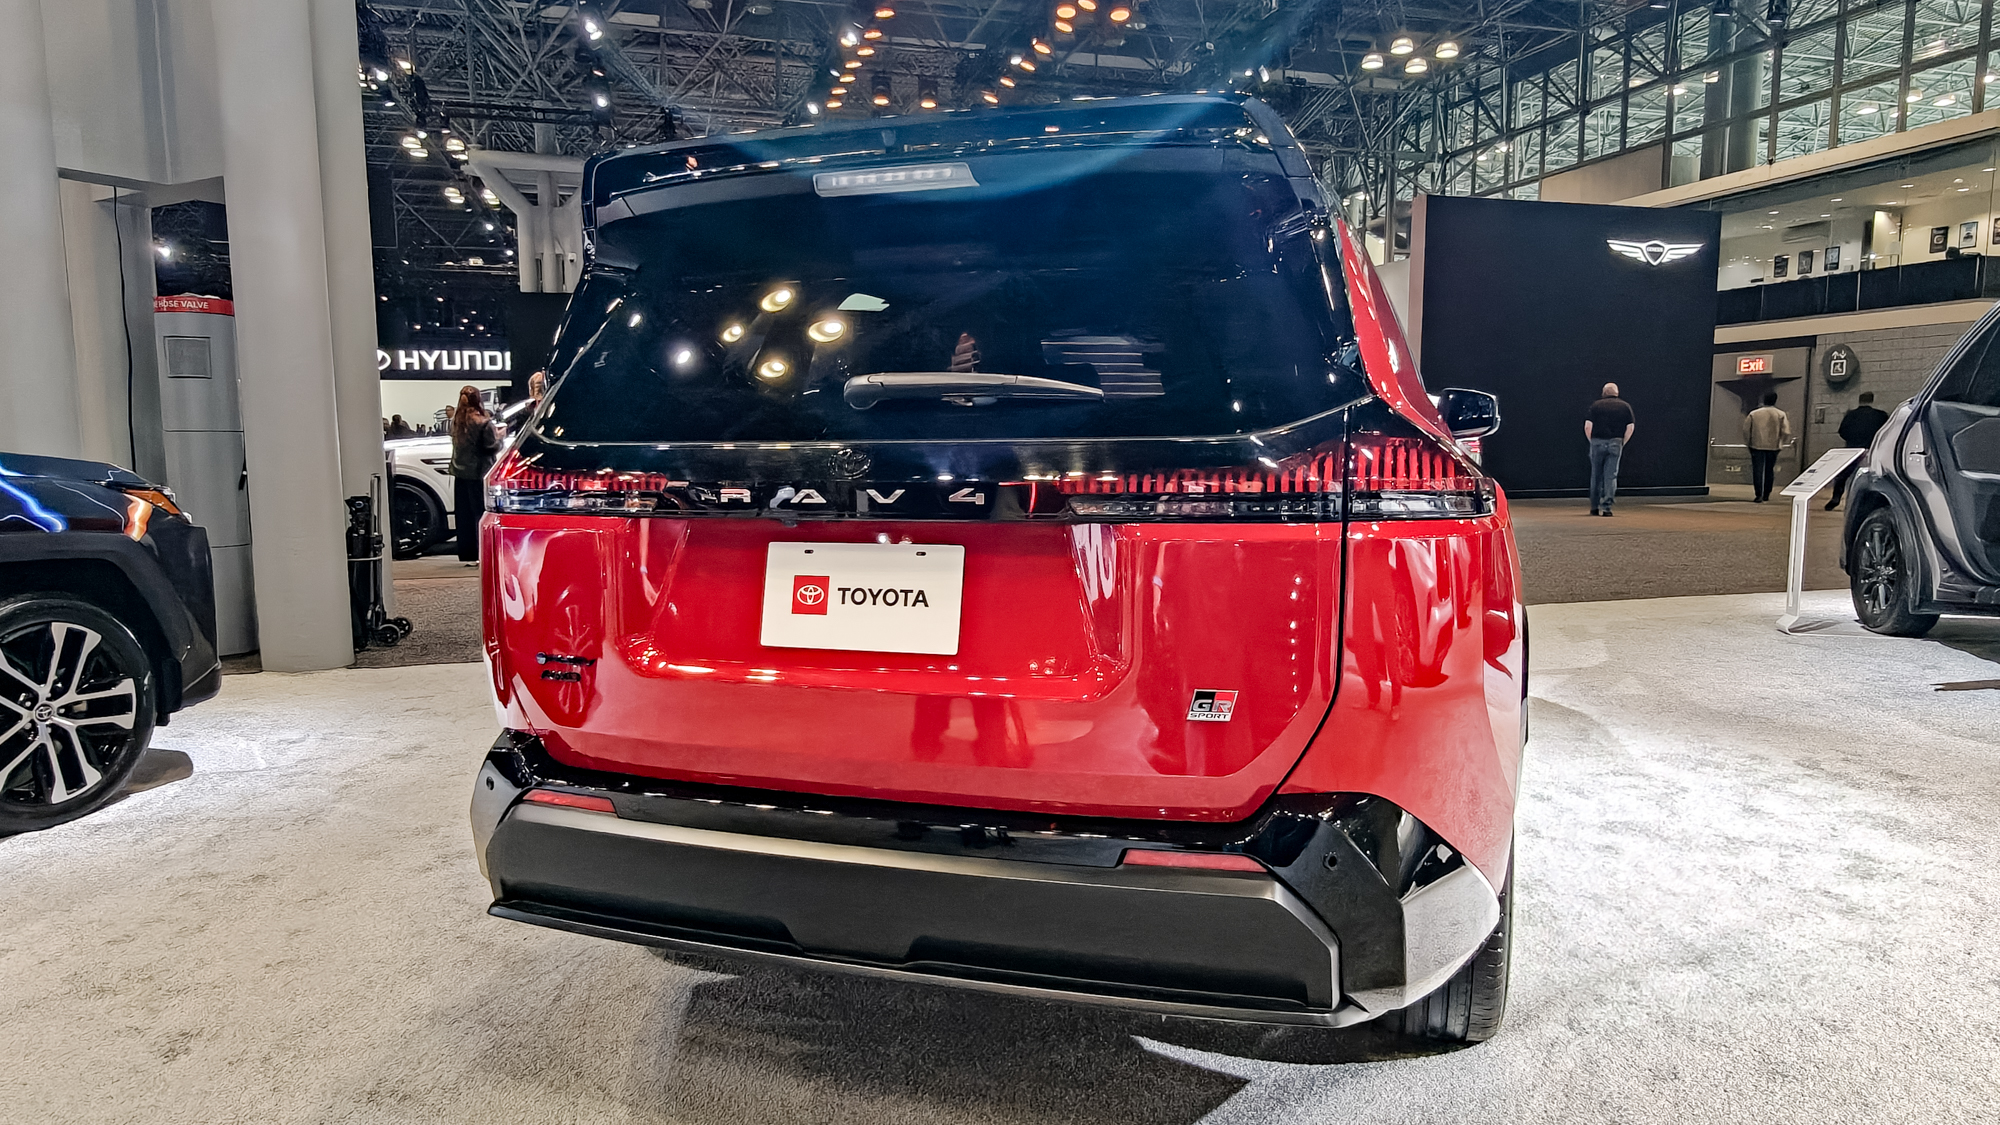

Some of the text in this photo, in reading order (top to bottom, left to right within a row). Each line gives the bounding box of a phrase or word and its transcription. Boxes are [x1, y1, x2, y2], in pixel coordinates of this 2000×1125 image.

[180, 300, 209, 309] VALVE
[1740, 358, 1765, 371] Exit
[838, 587, 929, 607] TOYOTA
[1192, 699, 1233, 713] GR
